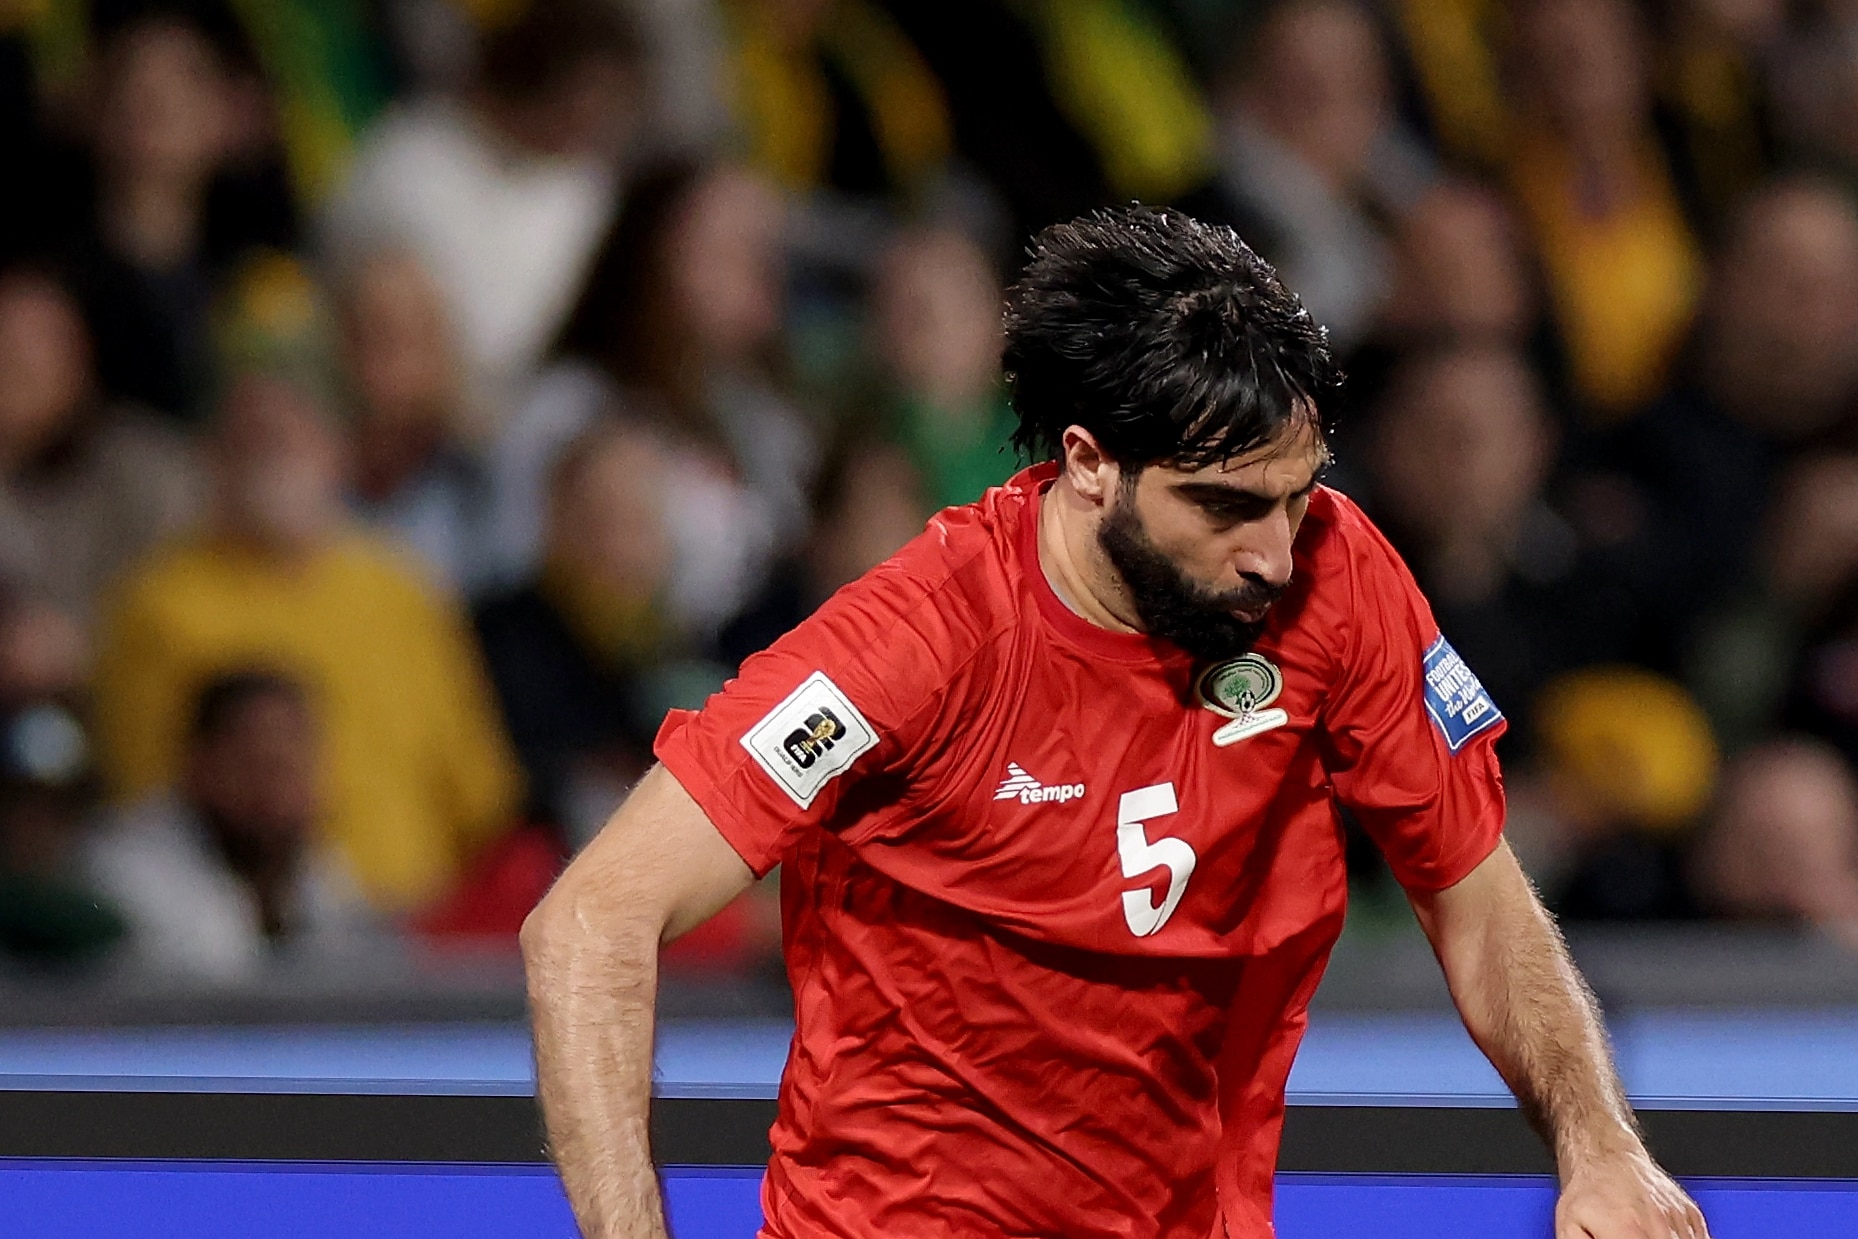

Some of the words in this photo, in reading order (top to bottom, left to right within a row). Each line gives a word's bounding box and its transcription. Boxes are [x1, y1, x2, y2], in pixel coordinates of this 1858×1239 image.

[1425, 651, 1461, 688] FOOTBAL
[1434, 659, 1473, 702] UNITES
[1444, 699, 1464, 718] the
[1466, 702, 1485, 719] FIFA
[1020, 783, 1086, 805] tempo
[1116, 781, 1197, 938] 5
